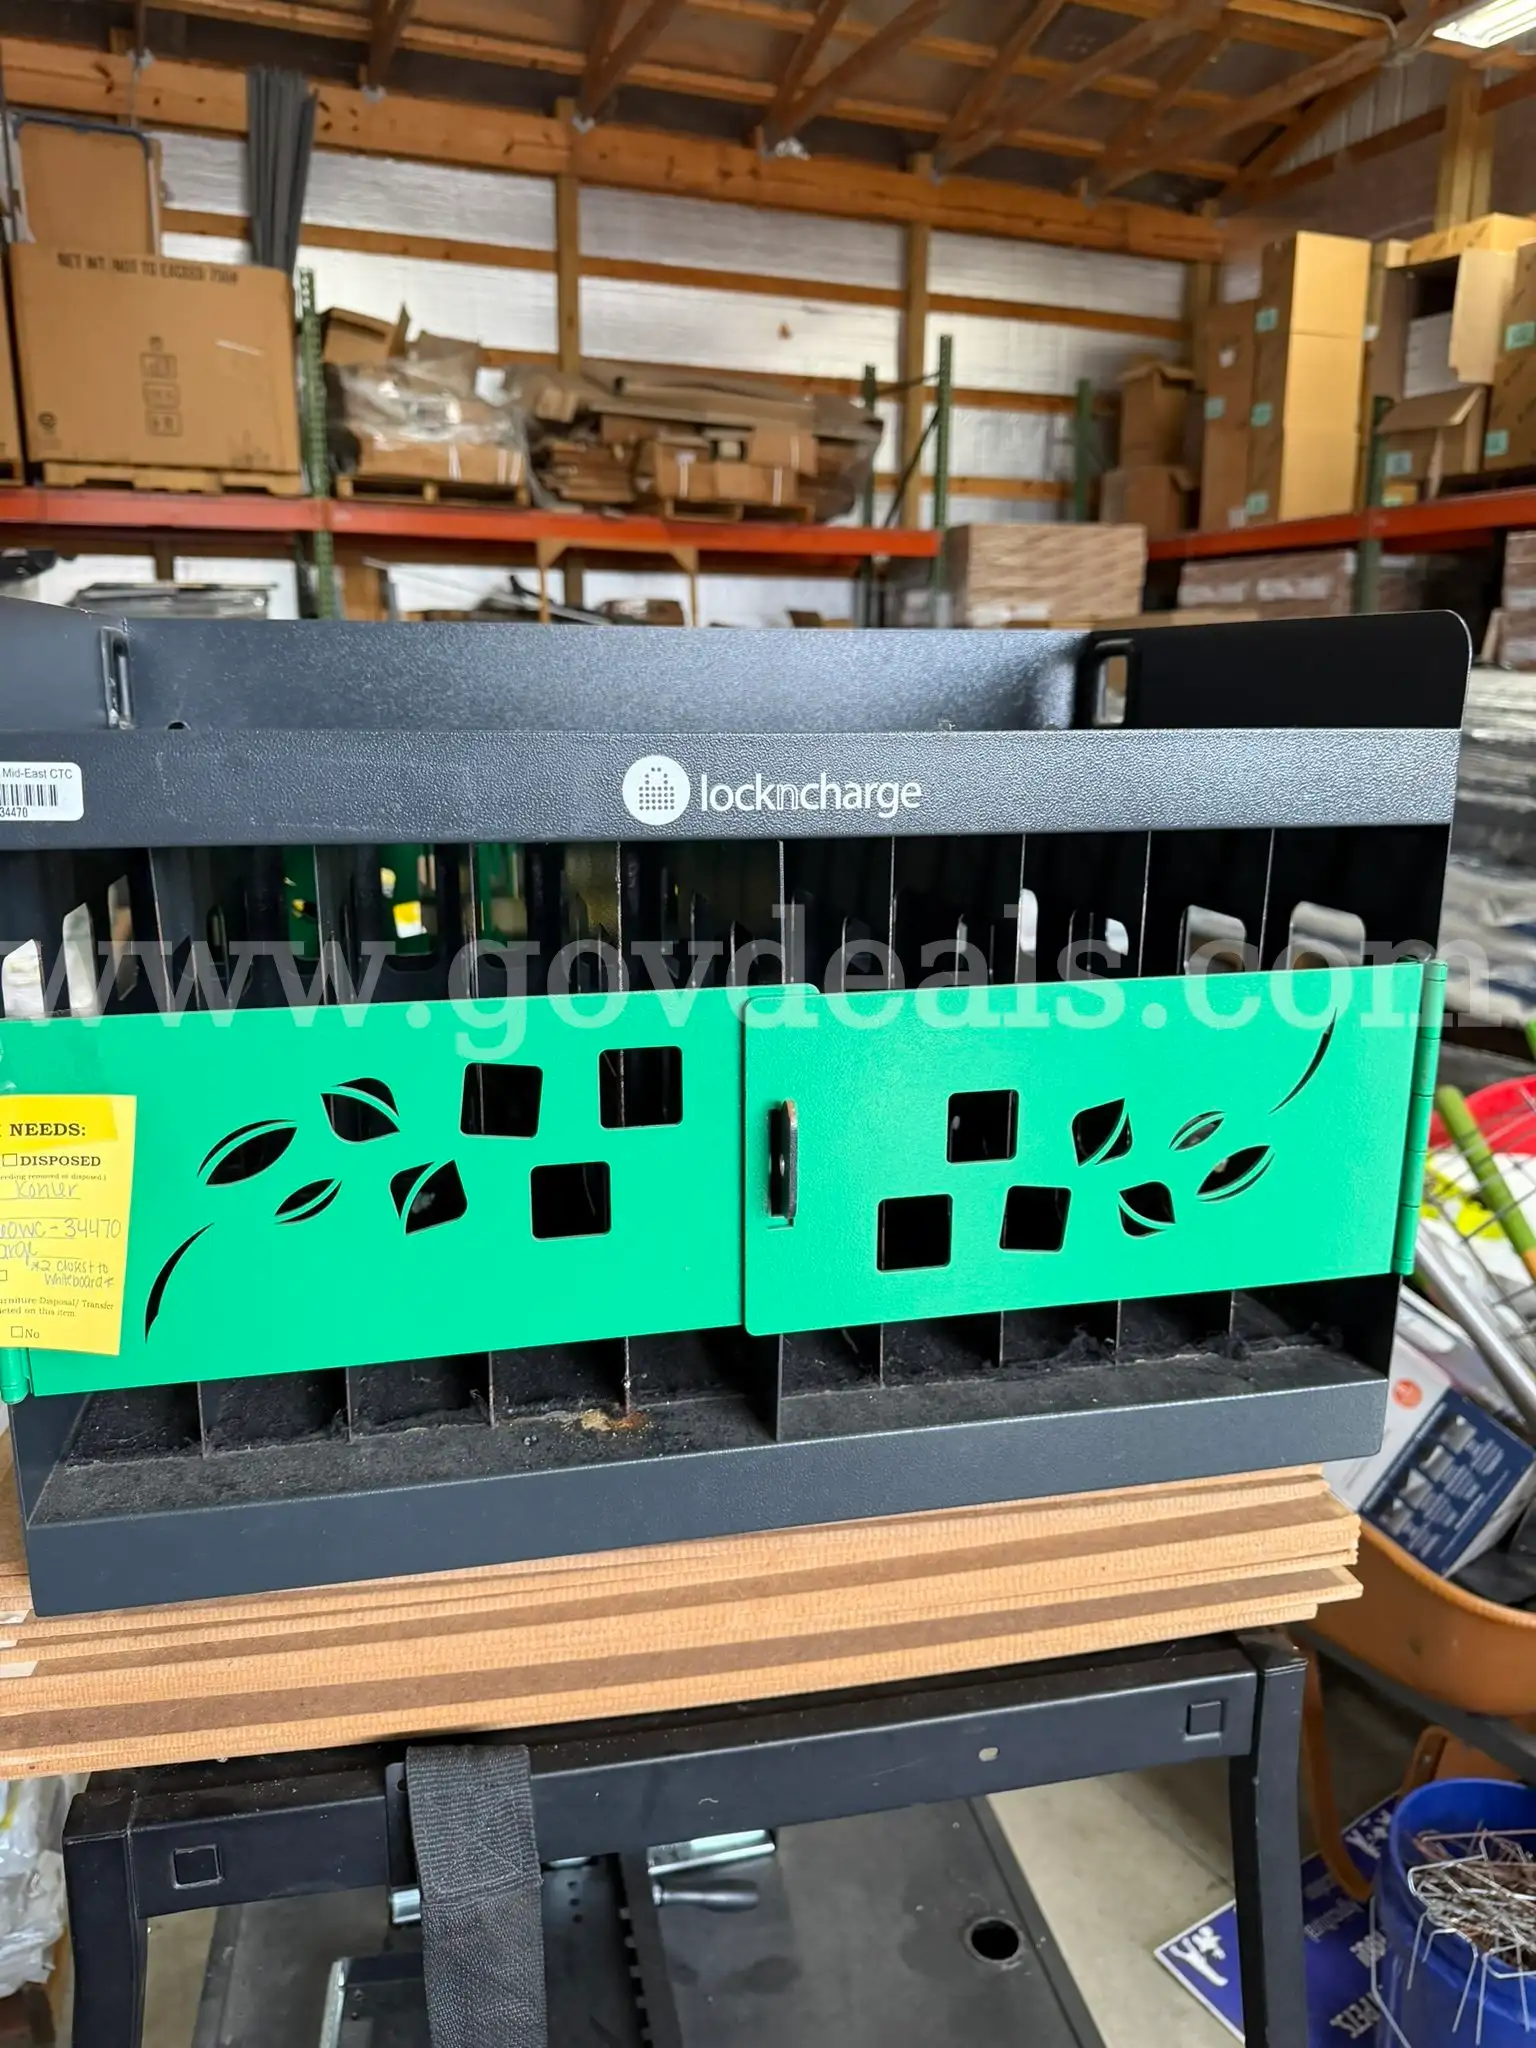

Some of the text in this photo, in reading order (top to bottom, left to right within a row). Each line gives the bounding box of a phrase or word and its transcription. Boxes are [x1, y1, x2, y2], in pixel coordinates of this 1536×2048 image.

[2, 768, 73, 779] Mid-East CTC
[701, 772, 922, 819] lockncharge
[0, 806, 28, 818] 34470
[9, 1122, 87, 1137] NEEDS:
[20, 1155, 102, 1167] DISPOSED
[0, 1306, 22, 1315] eted
[25, 1329, 40, 1338] No
